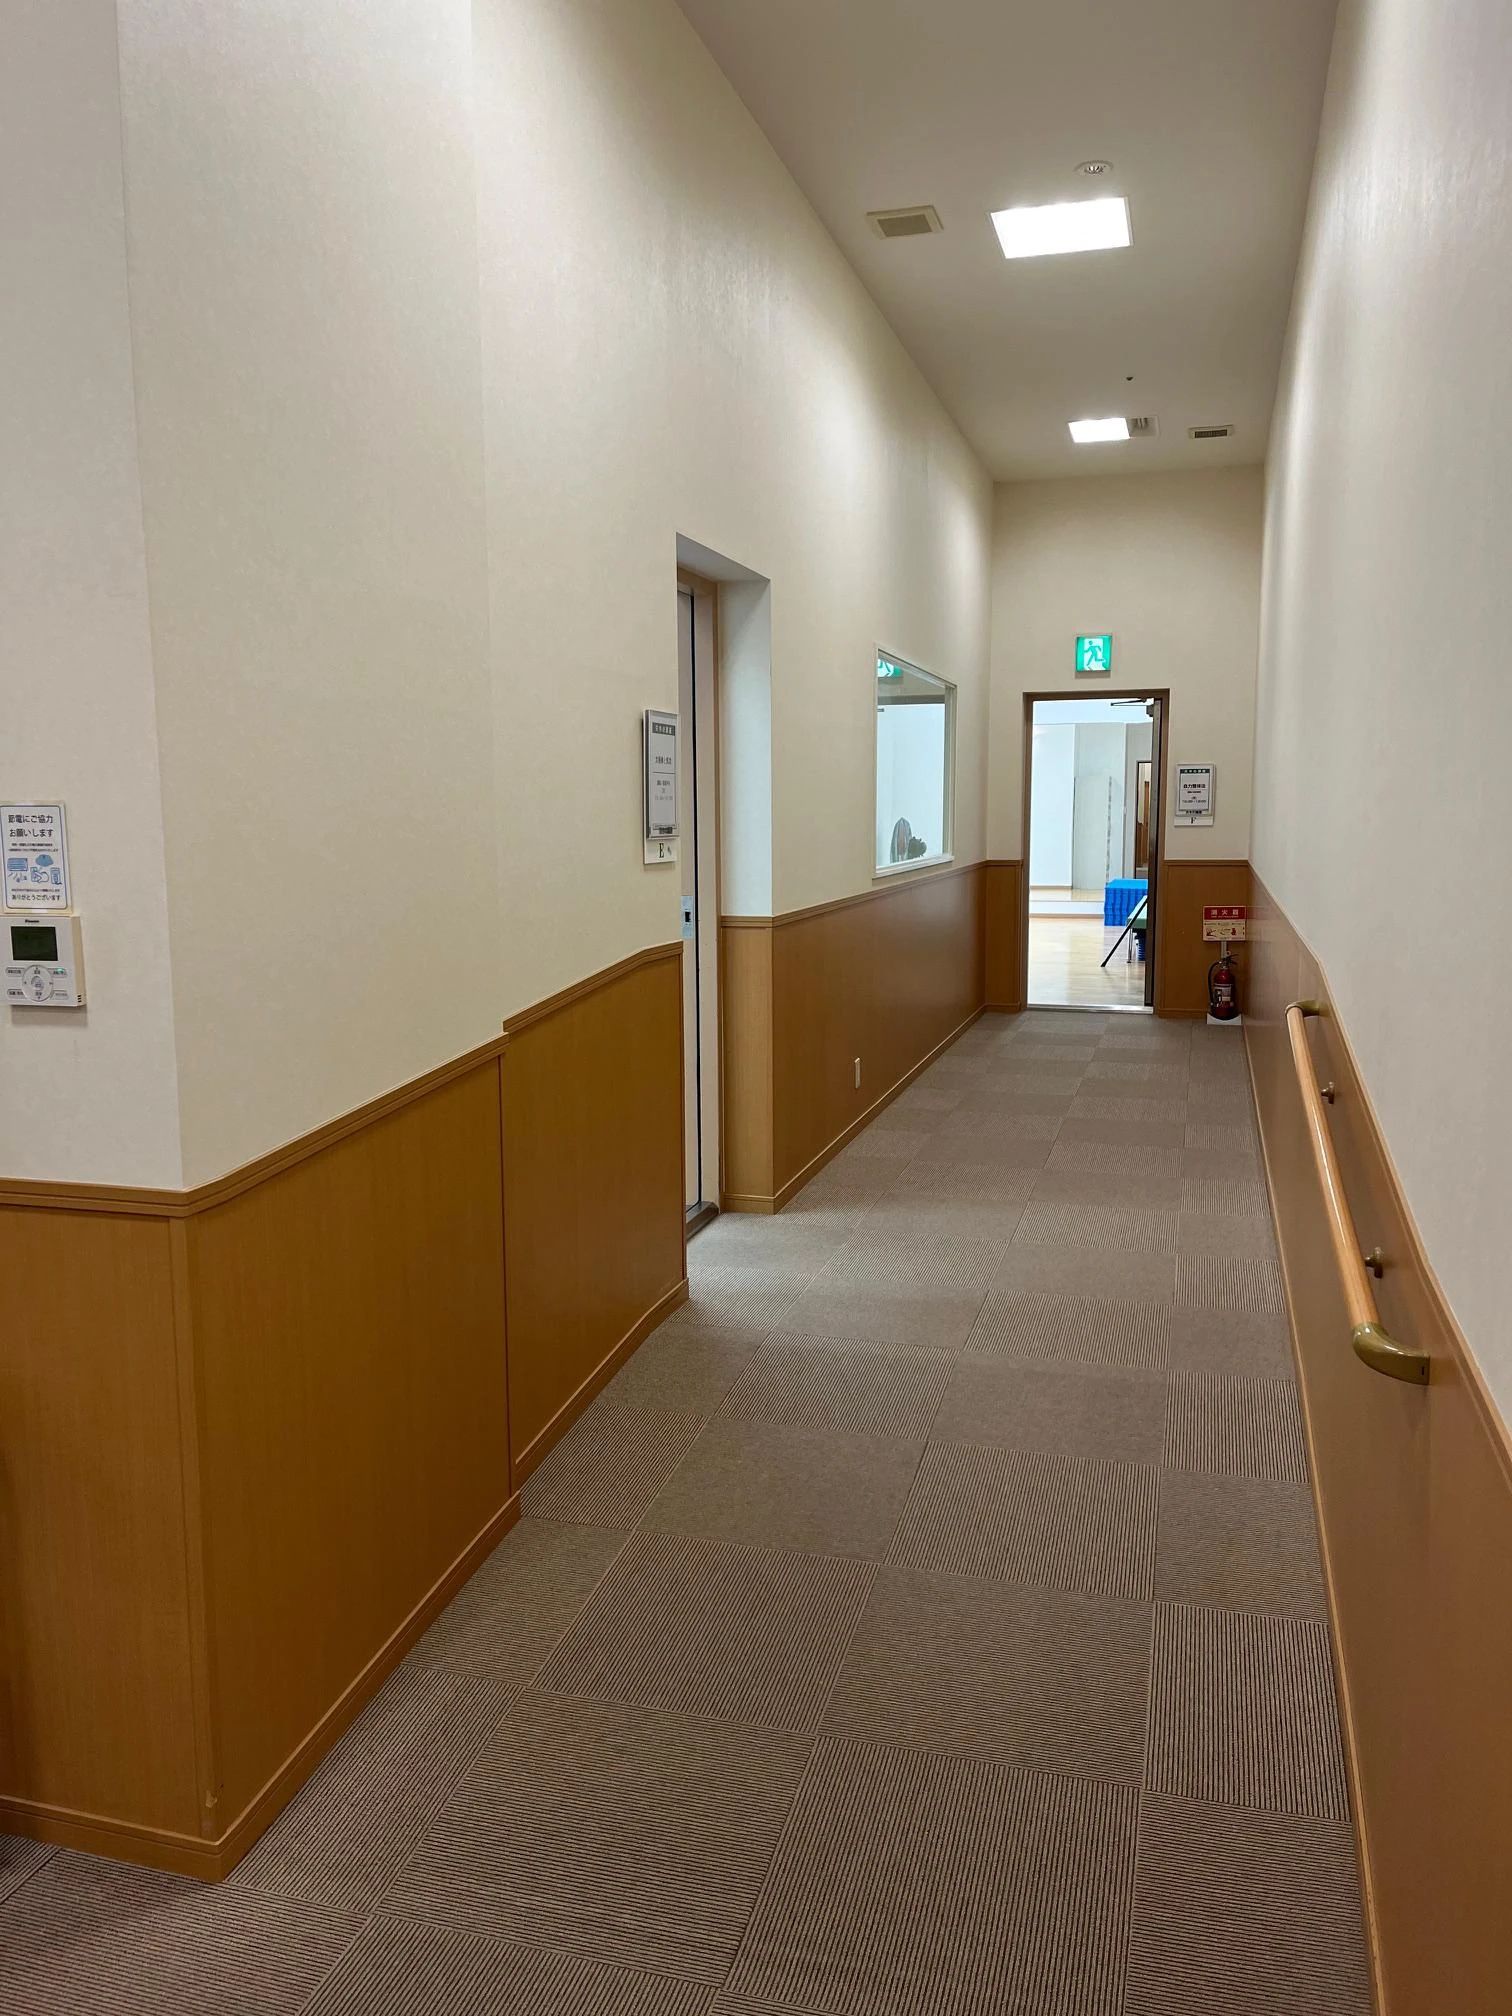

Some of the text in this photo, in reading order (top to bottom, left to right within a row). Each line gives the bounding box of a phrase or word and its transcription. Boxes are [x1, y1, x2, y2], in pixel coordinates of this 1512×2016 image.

[8, 814, 53, 823] 節電にご協力
[10, 828, 54, 837] お願いします
[659, 842, 665, 858] E
